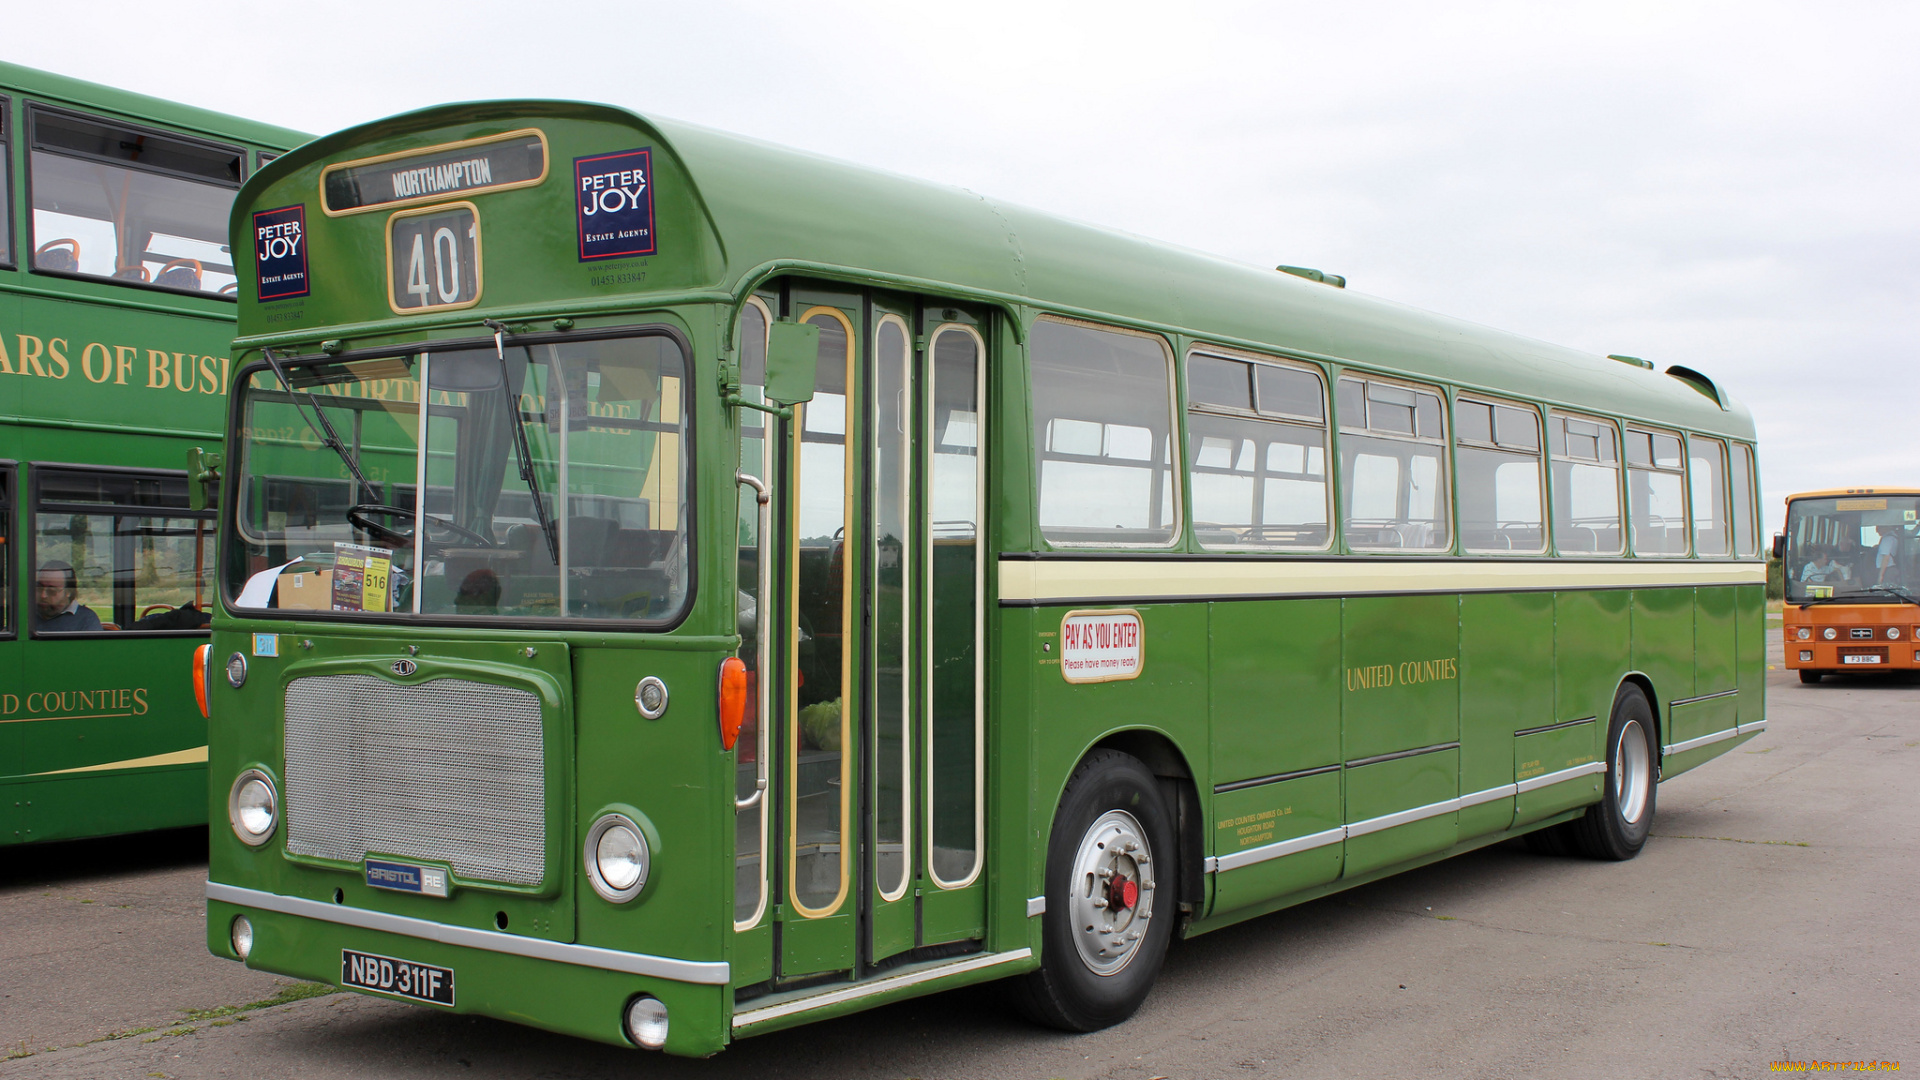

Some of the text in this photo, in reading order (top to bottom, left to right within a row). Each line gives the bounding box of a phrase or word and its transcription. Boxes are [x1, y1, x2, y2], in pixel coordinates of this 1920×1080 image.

[392, 158, 492, 197] NORTHAMPTON
[582, 169, 646, 191] PETER
[583, 184, 646, 216] JOY
[257, 221, 301, 240] PETER
[586, 229, 648, 242] ESTATE AGENTS
[259, 234, 301, 261] JOY
[588, 259, 649, 272] www.peterjoy.co.uk
[261, 272, 304, 284] ESTATE AGENTS
[591, 272, 646, 287] 01453 833847
[82, 342, 137, 385] OF
[365, 574, 386, 589] 516
[1065, 622, 1137, 650] PAY AS YOU ENTER
[392, 660, 415, 674] ECW
[1065, 656, 1136, 669] Please have money ready
[1347, 657, 1457, 691] UNITED COUNTIES
[26, 688, 149, 715] COUNTIES
[1217, 819, 1235, 829] UNITED
[1235, 814, 1256, 825] COUNTIES
[1256, 810, 1276, 821] OMNIBUS
[1237, 821, 1275, 836] HOUGHTON ROAD
[1239, 832, 1273, 846] NORTHAMPTON
[371, 867, 442, 888] BRISTOL RE
[351, 954, 442, 998] NBD 311F
